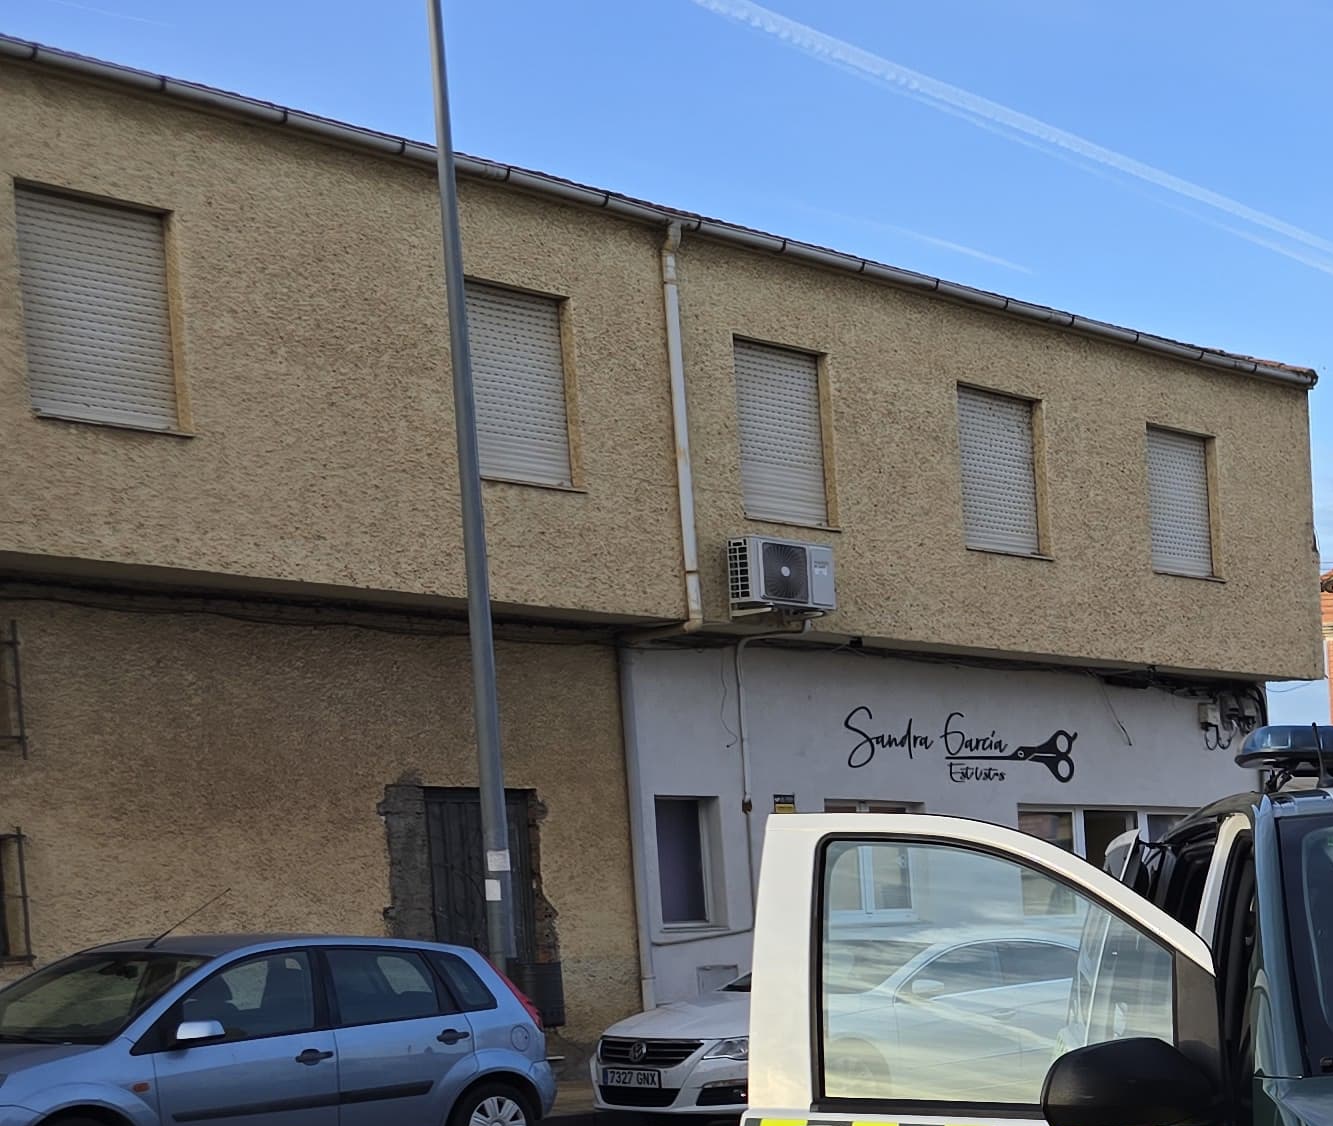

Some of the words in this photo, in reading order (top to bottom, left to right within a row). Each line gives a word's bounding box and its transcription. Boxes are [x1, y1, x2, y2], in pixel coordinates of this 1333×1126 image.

[843, 706, 934, 769] Sandra
[939, 711, 1009, 757] García
[609, 1070, 633, 1085] 7327
[636, 1071, 657, 1086] GNX
